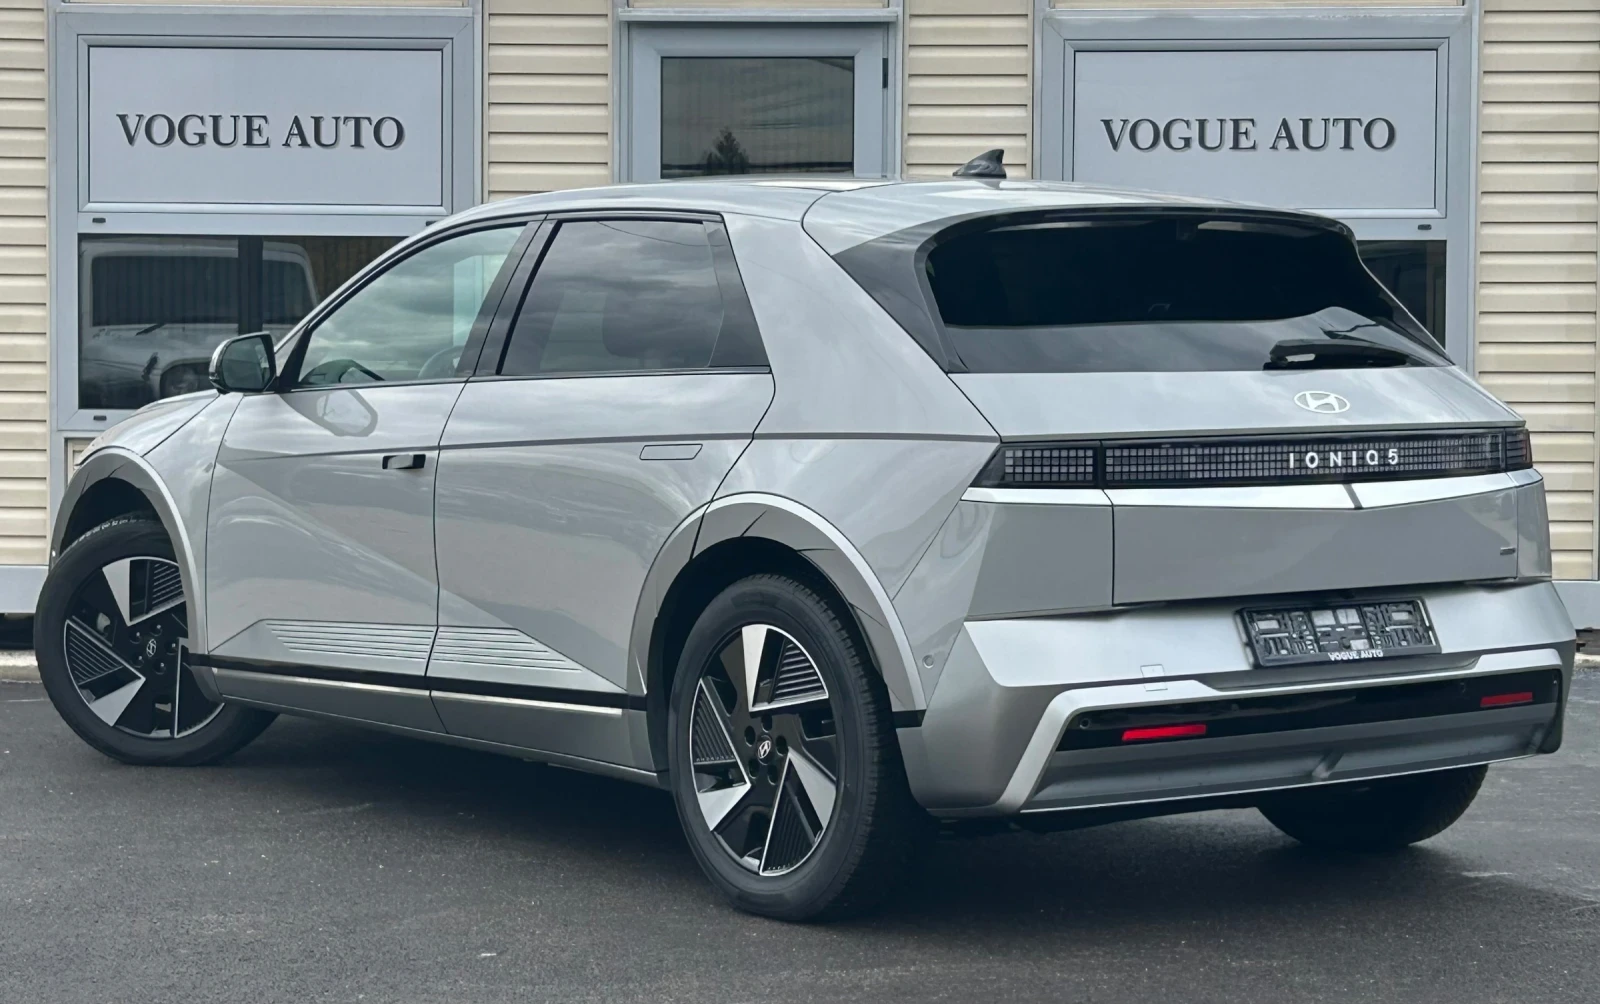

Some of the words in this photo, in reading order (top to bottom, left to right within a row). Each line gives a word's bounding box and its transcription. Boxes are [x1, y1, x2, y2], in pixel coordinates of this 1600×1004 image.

[116, 113, 270, 147] VOGUE
[282, 114, 406, 150] AUTO
[1100, 118, 1258, 152] VOGUE
[1269, 117, 1397, 152] AUTO
[1328, 650, 1360, 661] VOGUE
[1360, 649, 1384, 659] AUTO
